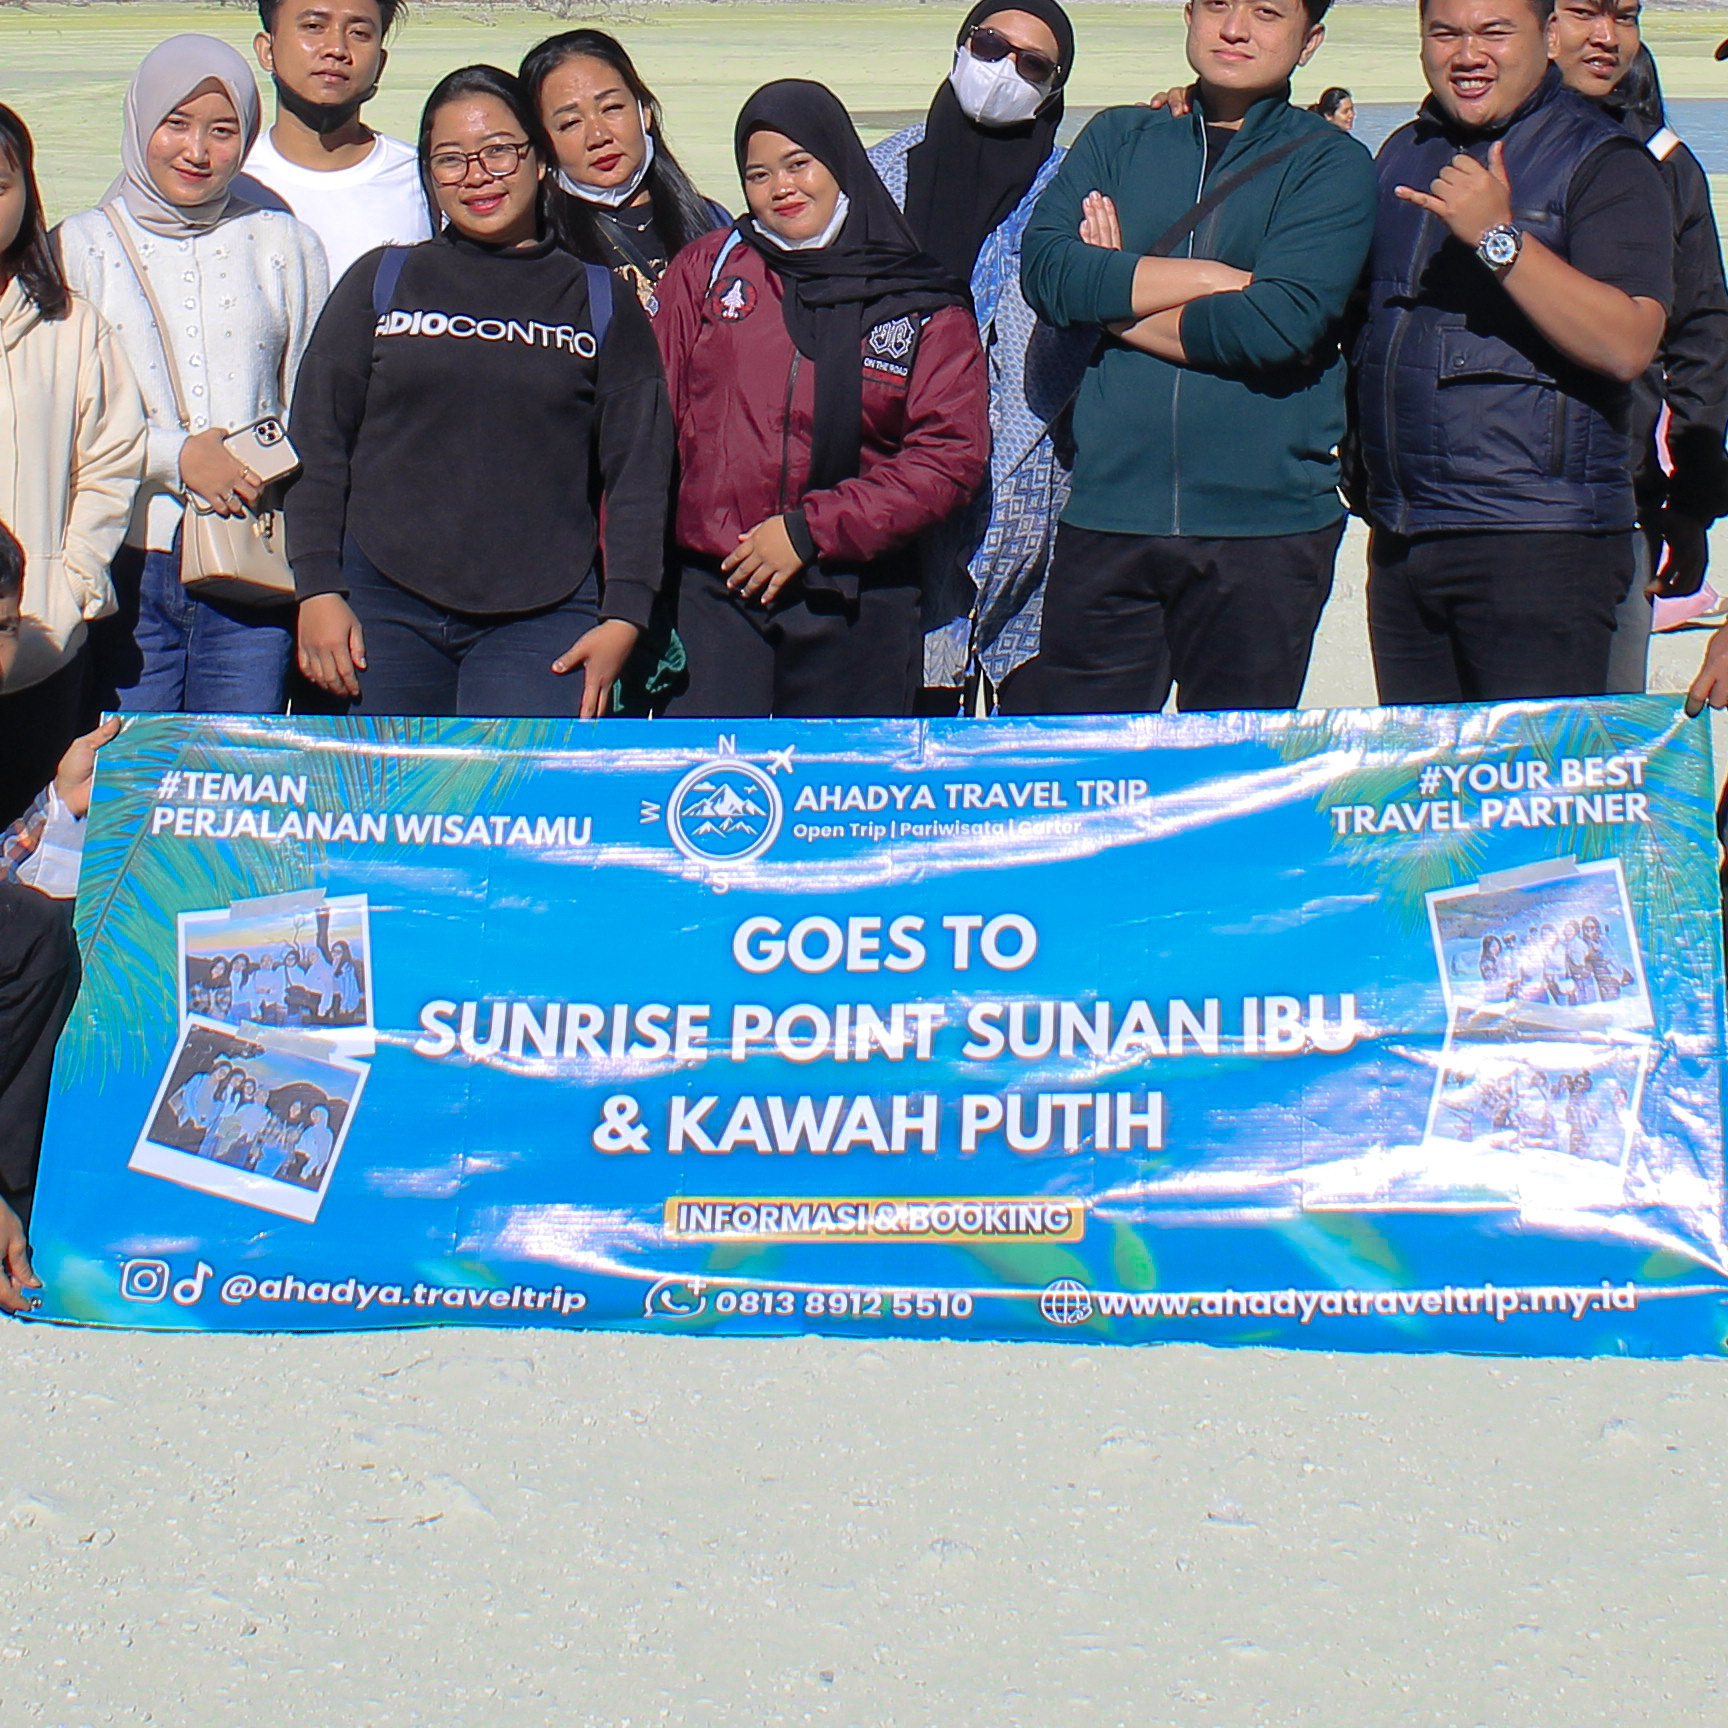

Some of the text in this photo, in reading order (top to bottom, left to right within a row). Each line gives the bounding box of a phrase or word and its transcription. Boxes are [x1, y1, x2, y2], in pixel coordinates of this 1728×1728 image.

[718, 733, 737, 756] N
[157, 771, 308, 804] #TEMAN
[1419, 755, 1649, 795] #YOUR BEST
[794, 779, 1150, 812] AHADYA TRAVEL TRIP
[1331, 792, 1652, 835] TRAVEL PARTNER
[151, 807, 594, 846] PERJALANAN WISATAMU
[793, 823, 845, 843] Open
[849, 821, 887, 842] Trip
[900, 819, 1004, 838] Pariwisata
[733, 912, 1039, 974] GOES TO
[413, 992, 1358, 1063] SUNRISE POINT SUNAN IBU
[592, 1090, 1165, 1155] & KAWAH PUTIH
[677, 1203, 1073, 1235] INFORMASI & BOOKING
[220, 1274, 587, 1315] @ahadya.traveltrip
[715, 1289, 973, 1318] 0813 8912 5510
[1098, 1279, 1639, 1324] www.ahadyatraveltrip.my.id
